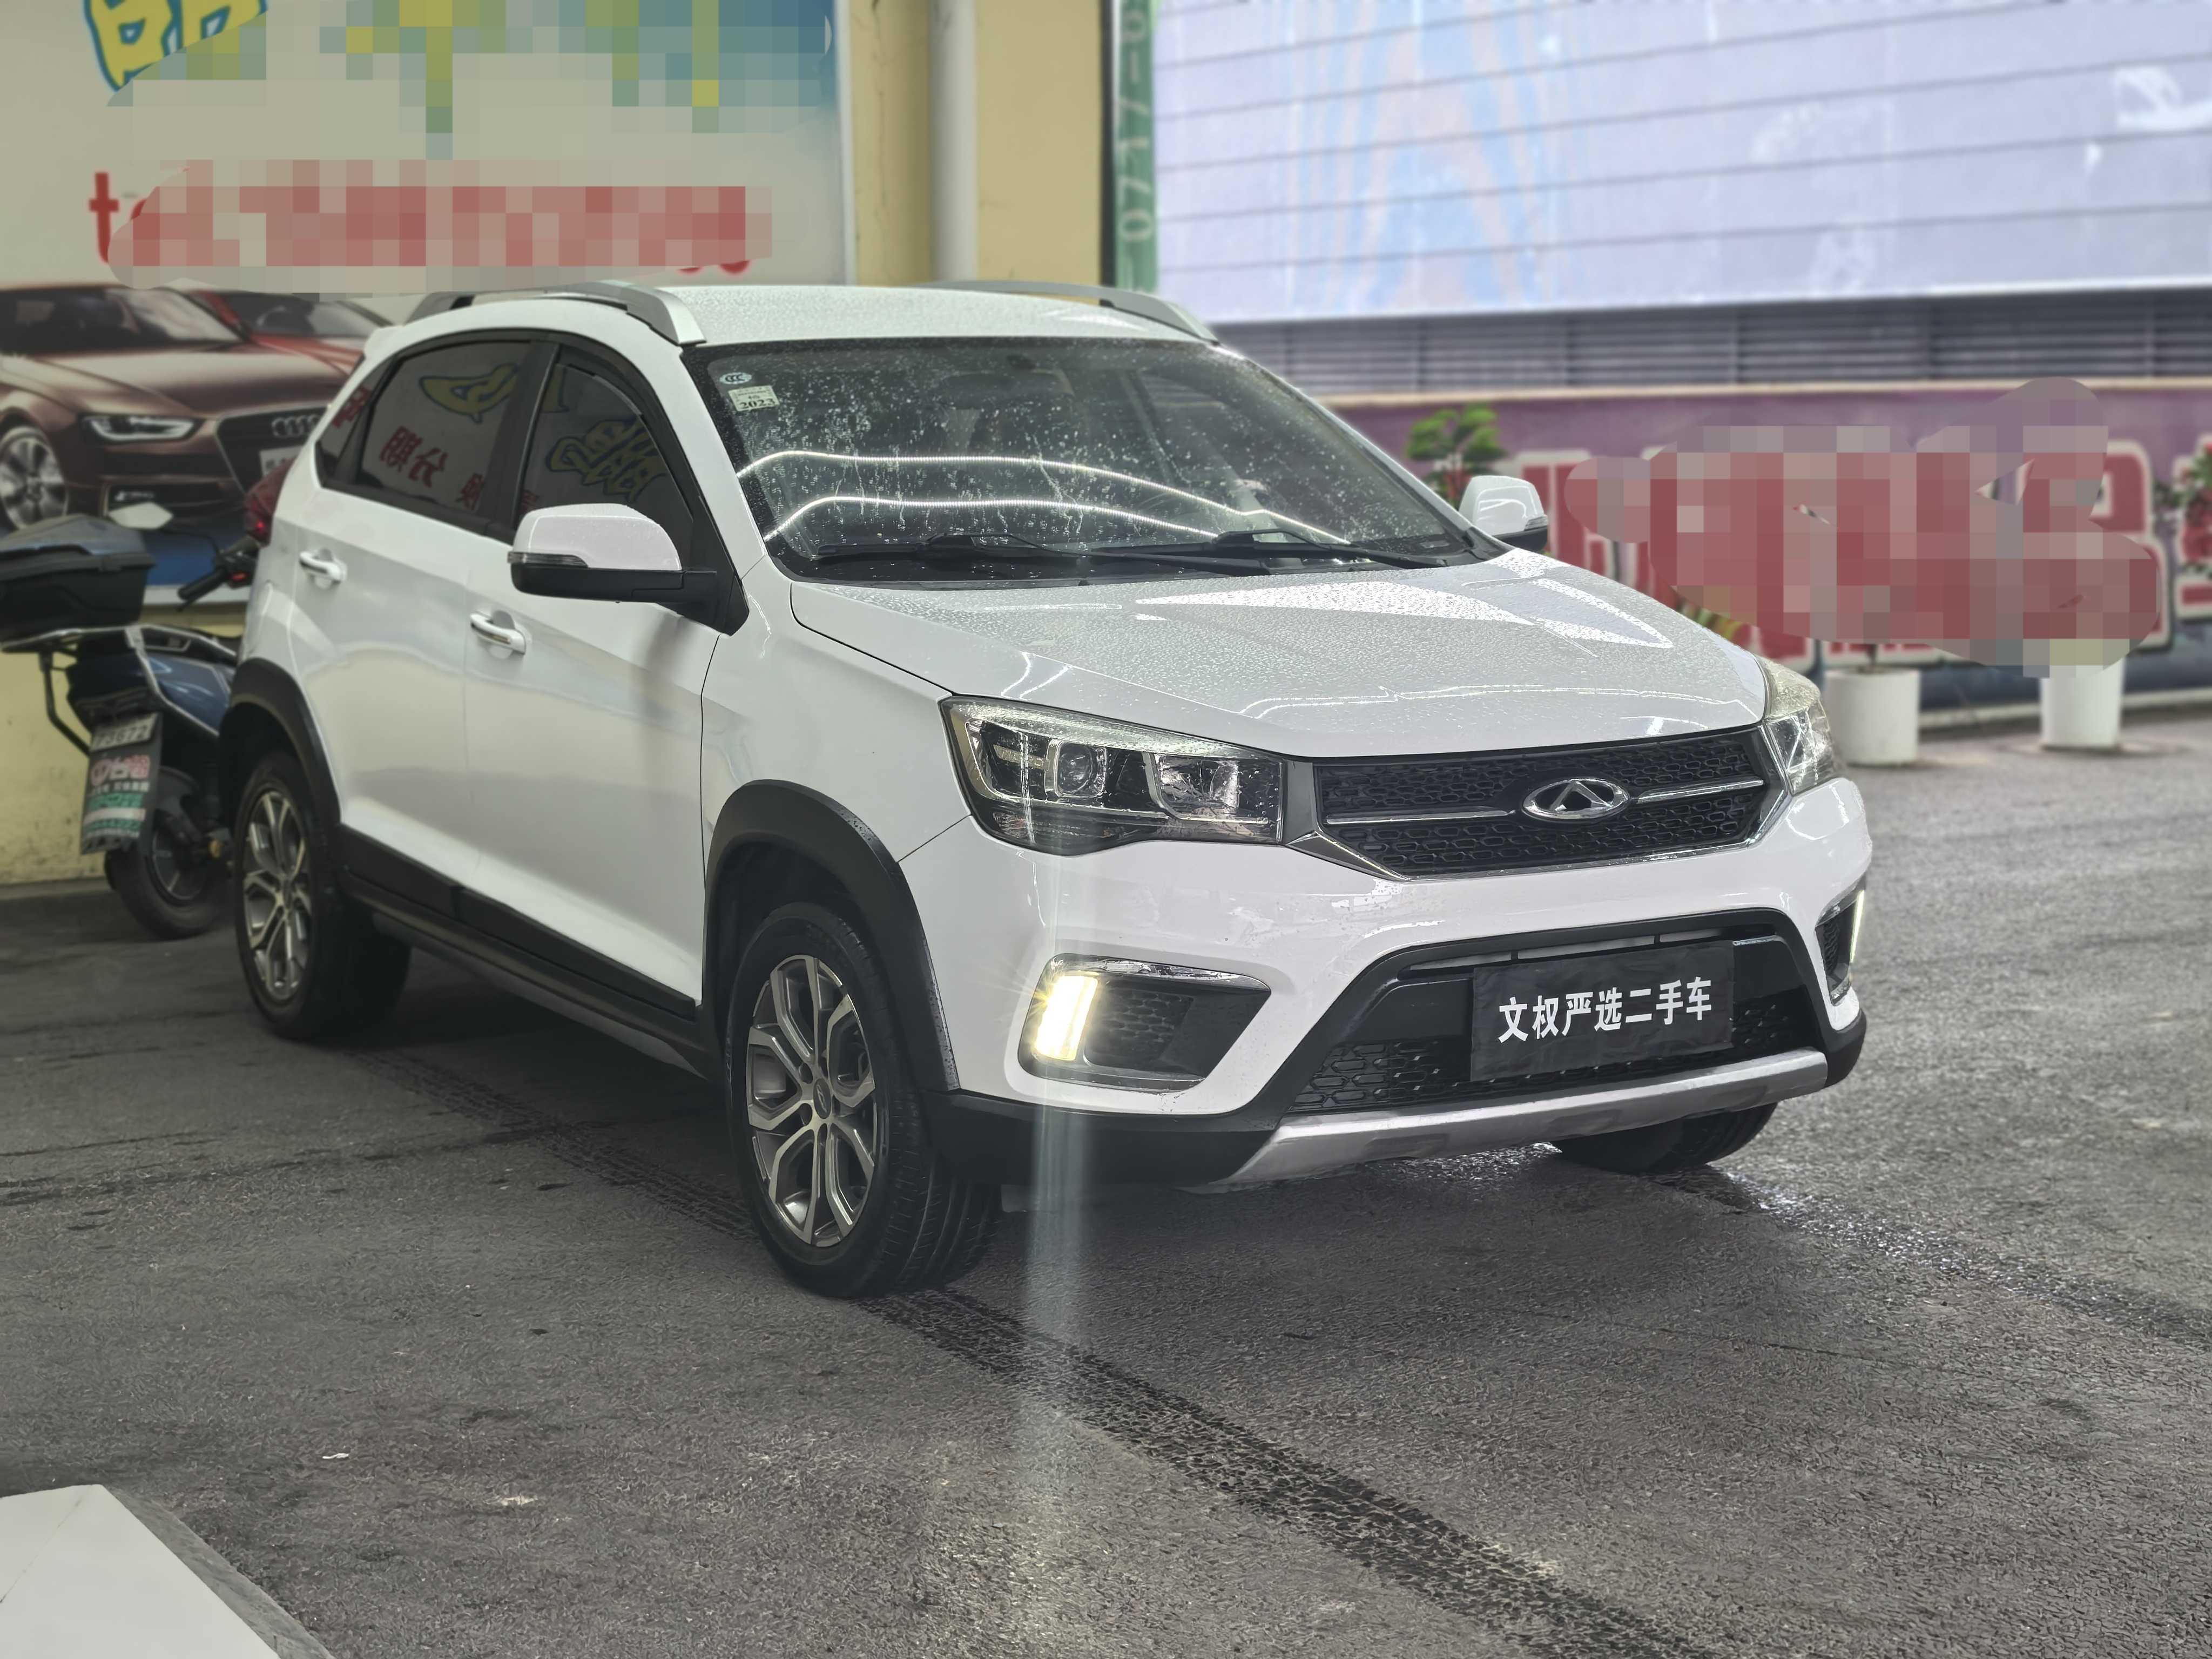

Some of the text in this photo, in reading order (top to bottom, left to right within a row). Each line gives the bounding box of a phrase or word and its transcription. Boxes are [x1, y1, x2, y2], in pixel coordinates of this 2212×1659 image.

[739, 398, 775, 409] 2023
[1498, 976, 1712, 1043] 文权严选二手车
